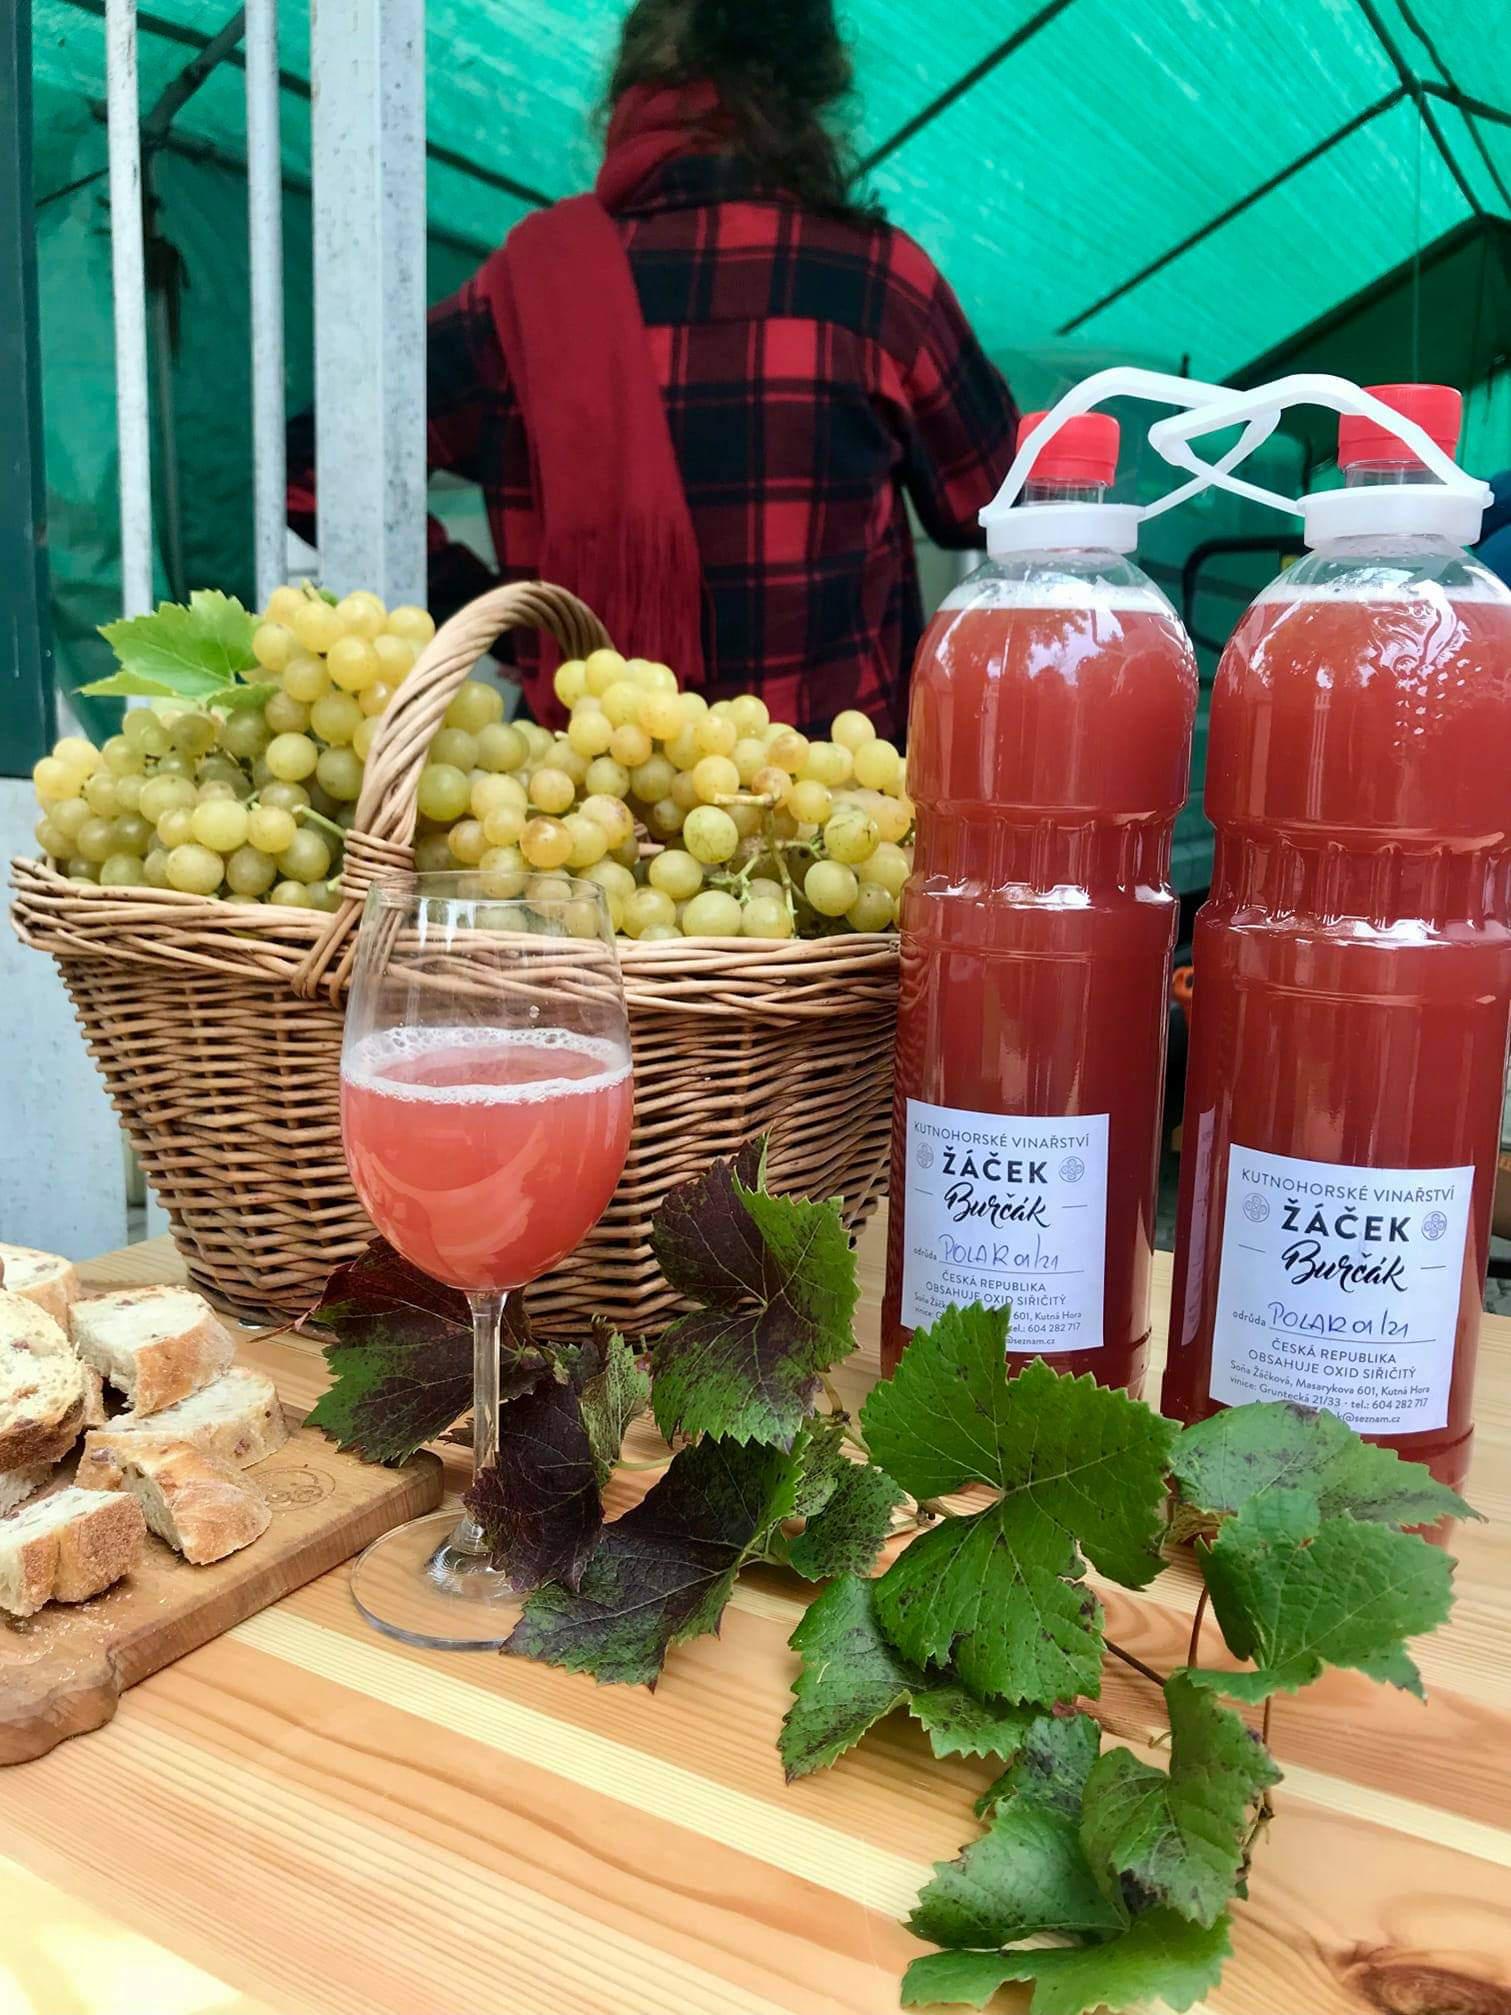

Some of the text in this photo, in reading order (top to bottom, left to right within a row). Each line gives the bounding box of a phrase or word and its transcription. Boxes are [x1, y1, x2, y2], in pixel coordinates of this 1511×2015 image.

[914, 1120, 1090, 1149] KUTNOHORSKÉ VINAŘSTVÍ
[942, 1145, 1049, 1184] ŽÁČEK
[1241, 1167, 1455, 1202] KUTNOHORSKÉ VINAŘSTVÍ
[943, 1181, 1051, 1230] Burčák
[1280, 1197, 1412, 1243] ŽÁČEK
[942, 1271, 1046, 1293] ČESKÁ REPUBLIKA
[1280, 1239, 1409, 1293] Burčák
[925, 1280, 1067, 1306] OBSAHUJE OXID SIŘIČITÝ
[1027, 1323, 1046, 1333] 604
[1048, 1323, 1066, 1333] 282
[1067, 1321, 1081, 1331] 717
[1035, 1311, 1060, 1321] Kutná
[1062, 1311, 1082, 1320] Hora
[1232, 1310, 1267, 1327] odrůda
[1248, 1348, 1417, 1380] OBSAHUJE OXID SIŘIČITÝ
[1271, 1337, 1397, 1364] ČESKÁ REPUBLIKA
[1230, 1359, 1430, 1397] Soňa Žáčková, Masarykova 601, Kutná Hora
[1230, 1376, 1257, 1391] vinice:
[1259, 1383, 1310, 1403] Gruntecká
[1312, 1395, 1341, 1407] 21/33
[1372, 1400, 1392, 1410] 604
[1395, 1399, 1413, 1409] 282
[1414, 1397, 1429, 1408] 717
